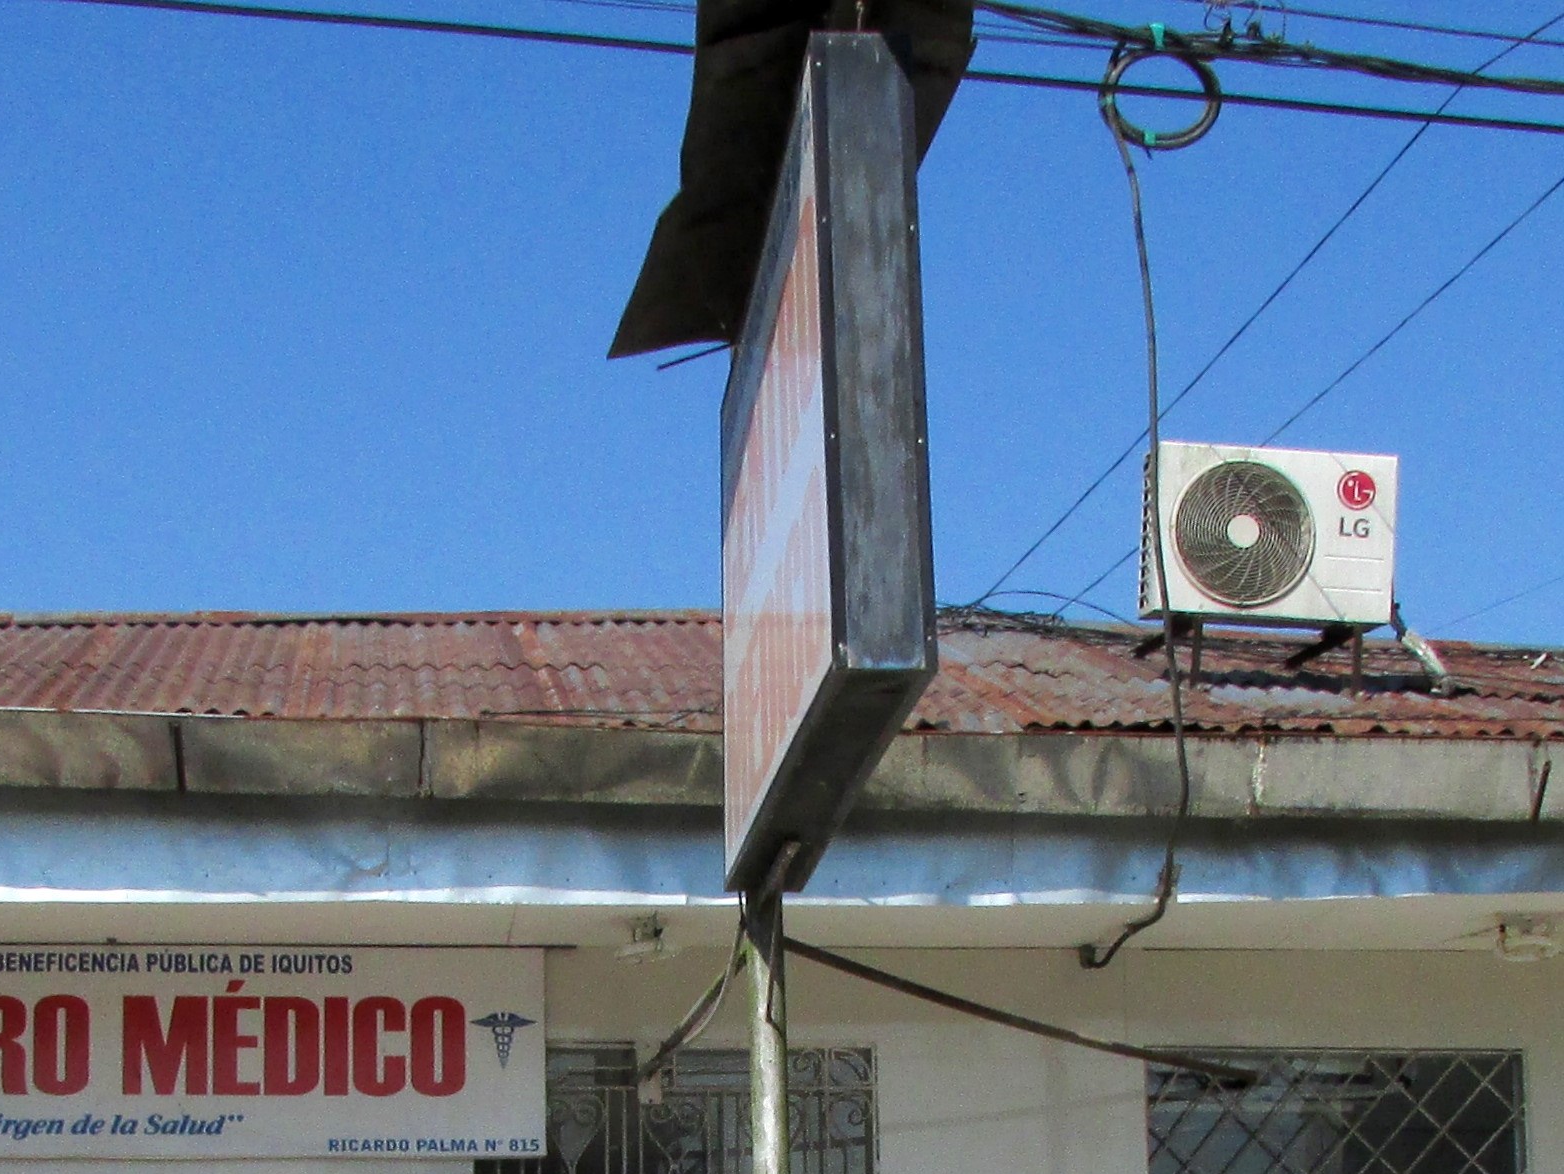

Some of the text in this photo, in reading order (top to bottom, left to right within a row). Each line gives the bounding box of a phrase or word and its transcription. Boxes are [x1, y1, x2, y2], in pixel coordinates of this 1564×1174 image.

[1339, 517, 1370, 538] LG
[147, 949, 233, 973] PÚBLICA
[240, 954, 264, 973] DE
[272, 954, 352, 975] IQUITOS
[122, 979, 467, 1097] MÉDICO
[71, 1114, 104, 1135] de
[111, 1114, 137, 1135] la
[328, 1139, 410, 1152] RICARDO
[416, 1139, 478, 1152] PALMA
[509, 1139, 539, 1152] 815
